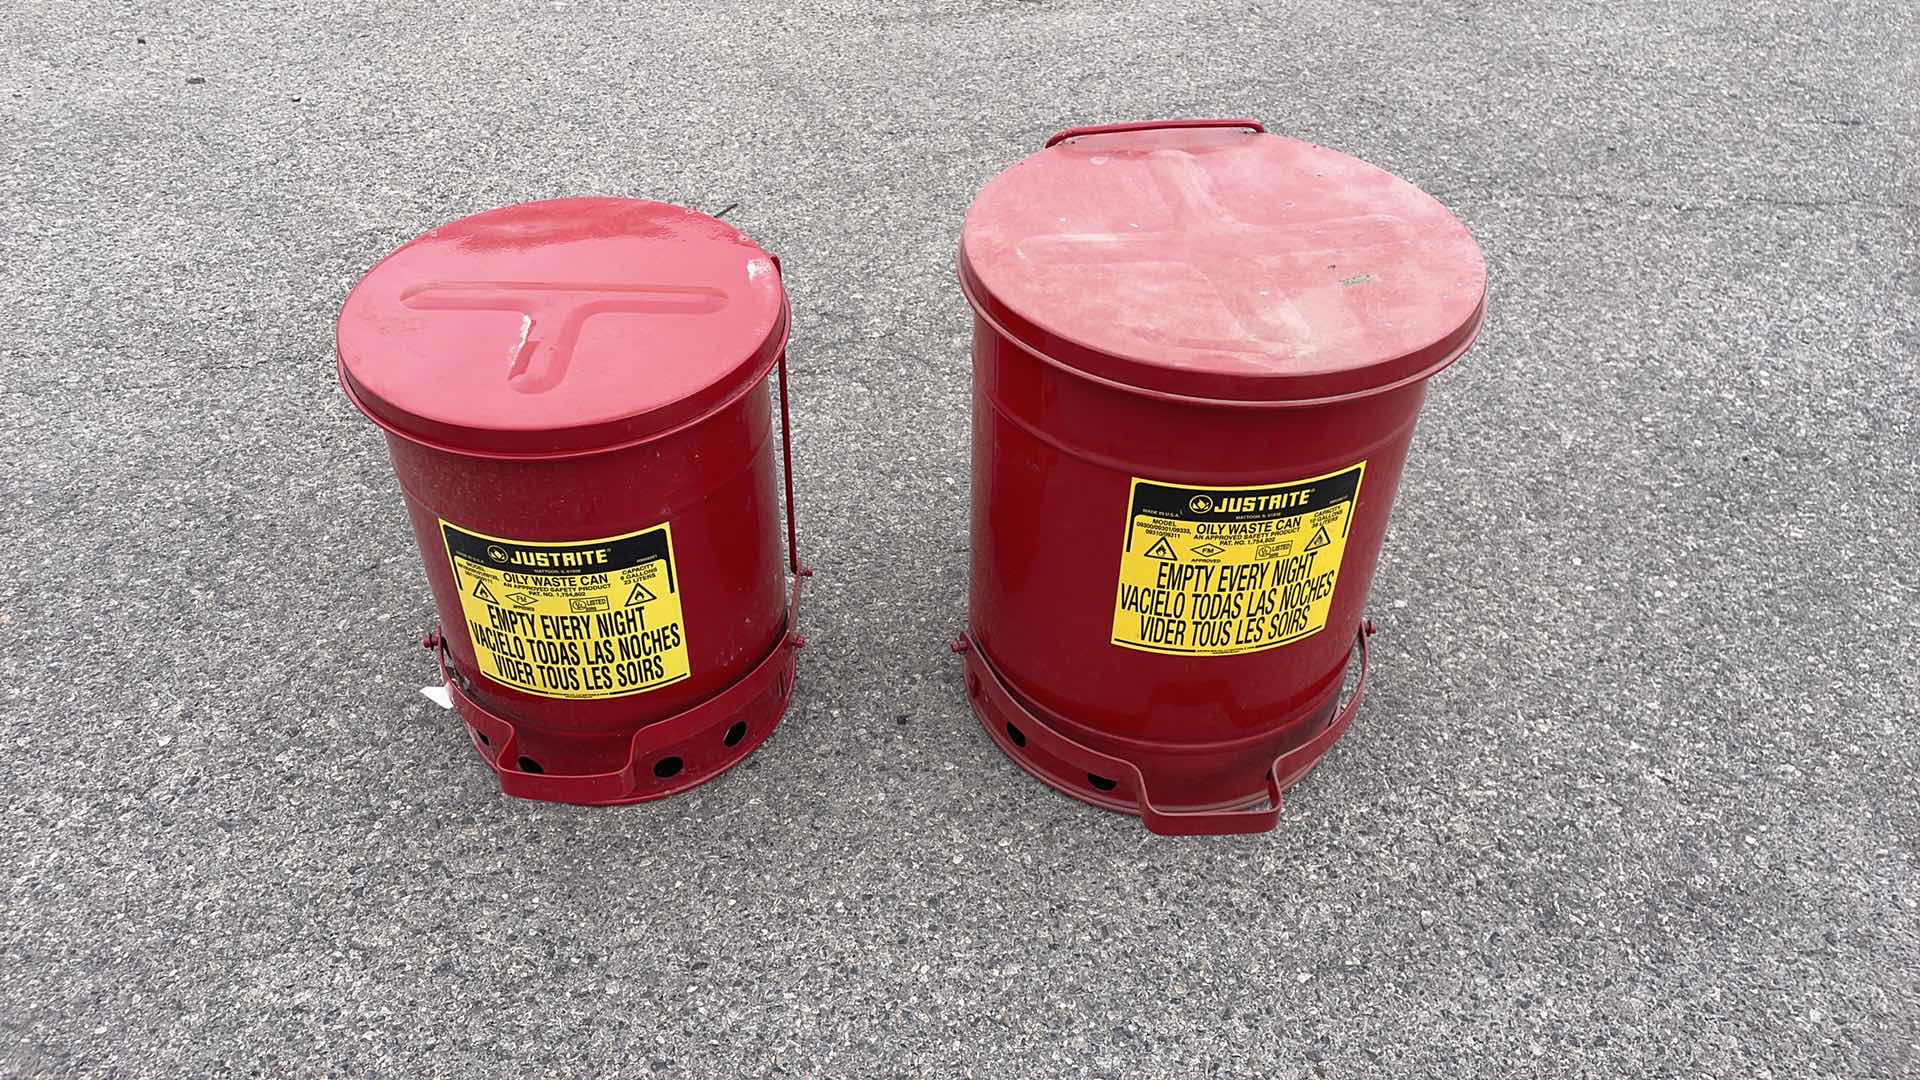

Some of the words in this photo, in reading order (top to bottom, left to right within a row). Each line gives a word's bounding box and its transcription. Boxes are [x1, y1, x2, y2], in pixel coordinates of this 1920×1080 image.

[1214, 489, 1310, 512] JUSTRITE
[1196, 524, 1226, 534] OILY
[1228, 521, 1272, 534] WASTE
[1276, 517, 1302, 530] CAN
[1270, 527, 1301, 536] PRODUCT
[511, 549, 608, 566] JUSTRITE
[622, 564, 654, 574] CAPACITY
[626, 567, 657, 579] GALLONS
[633, 573, 656, 582] LITERS
[1157, 562, 1215, 592] EMPTY
[1218, 562, 1270, 592] EVERY
[1271, 551, 1318, 587] NIGHT
[504, 573, 529, 586] OILY
[531, 576, 577, 587] WASTE
[581, 574, 608, 586] CAN
[514, 584, 549, 592] APPROVED
[1121, 583, 1186, 618] VACIELO
[1192, 592, 1241, 620] TODAS
[1246, 588, 1278, 618] LAS
[1279, 570, 1335, 613] NOCHES
[487, 605, 537, 638] EMPTY
[540, 615, 591, 640] EVERY
[596, 606, 645, 638] NIGHT
[1140, 615, 1186, 645] VIDER
[1192, 620, 1232, 647] TOUS
[1235, 617, 1265, 645] LES
[1268, 605, 1310, 640] SOIRS
[470, 620, 525, 660] VACIELO
[526, 638, 580, 666] TODAS
[585, 639, 615, 666] LAS
[618, 623, 680, 662] NOCHES
[493, 653, 537, 686] VIDER
[537, 664, 580, 691] TOUS
[583, 665, 613, 691] LES
[617, 655, 664, 687] SOIRS
